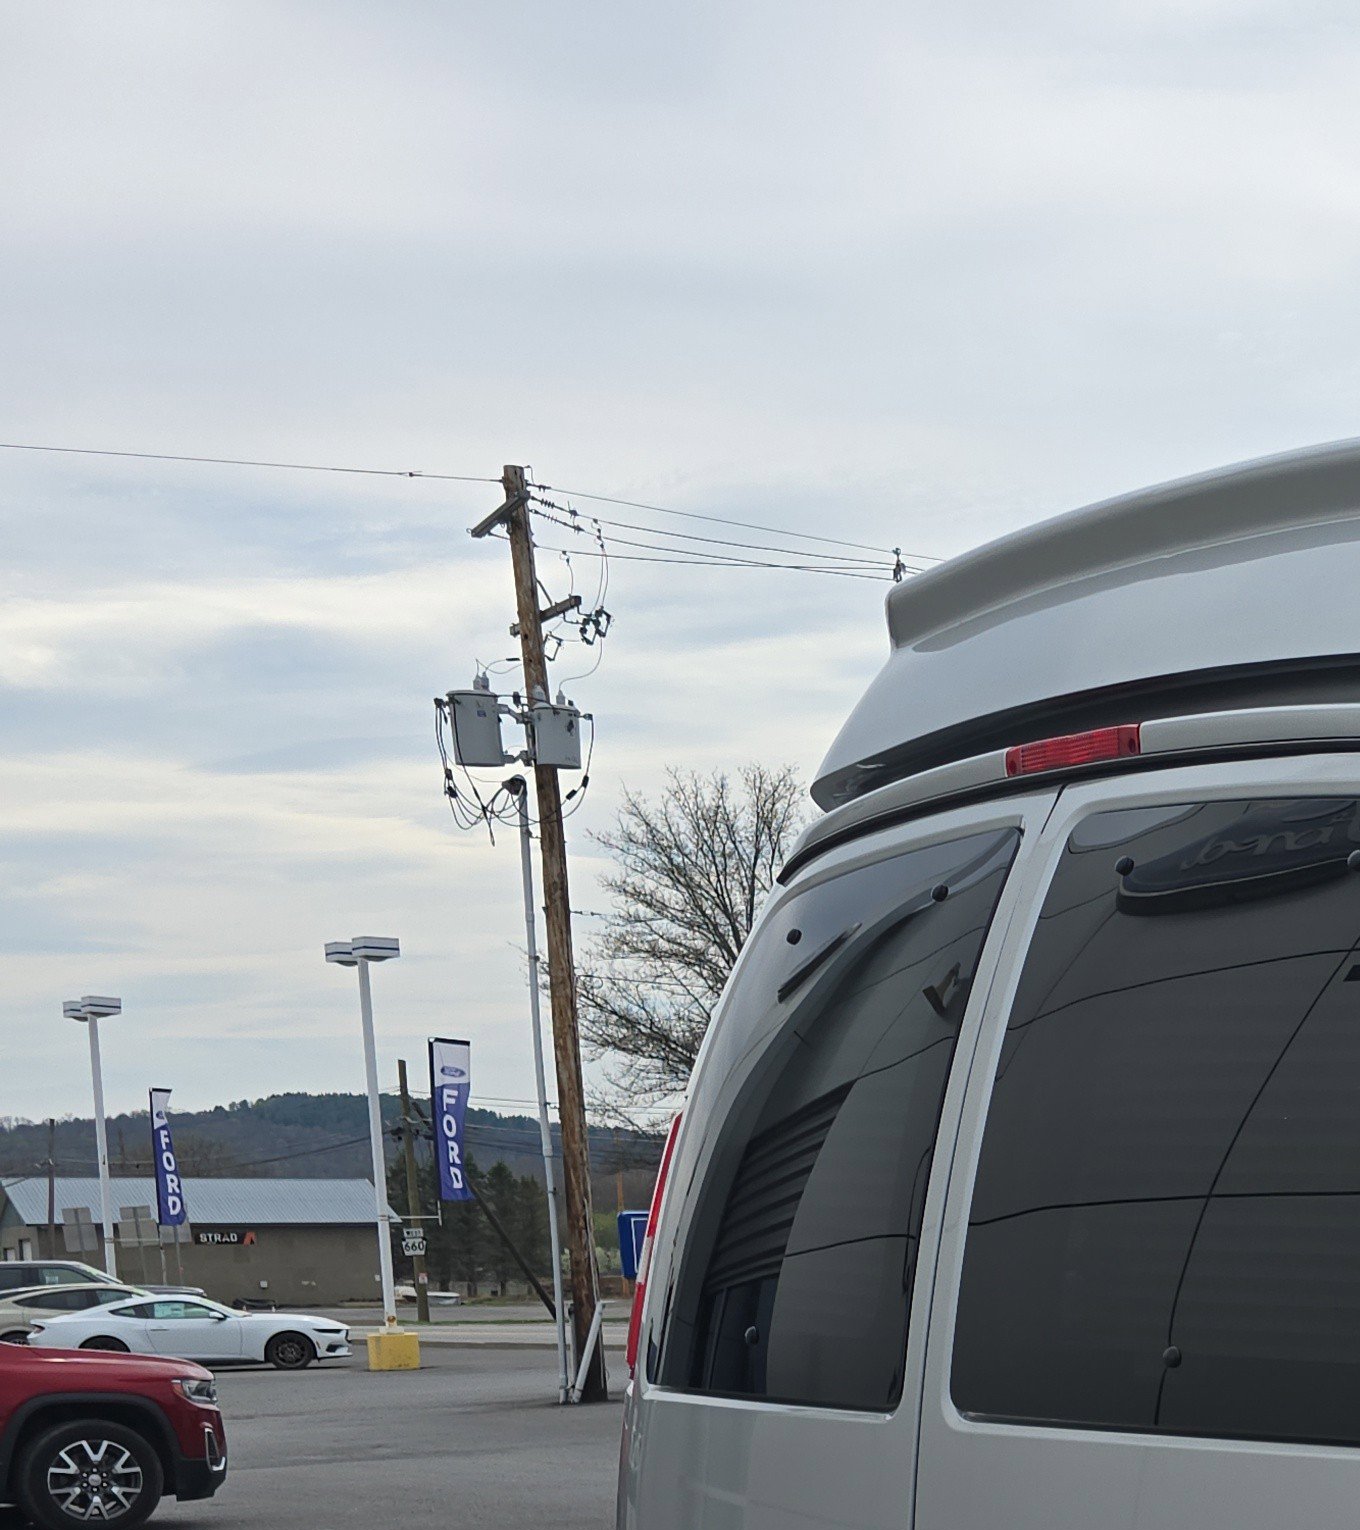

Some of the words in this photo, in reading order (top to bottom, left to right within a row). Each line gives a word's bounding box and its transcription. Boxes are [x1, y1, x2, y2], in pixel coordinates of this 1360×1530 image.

[160, 1130, 181, 1215] FORD
[442, 1088, 463, 1189] FORD
[405, 1241, 424, 1251] 660
